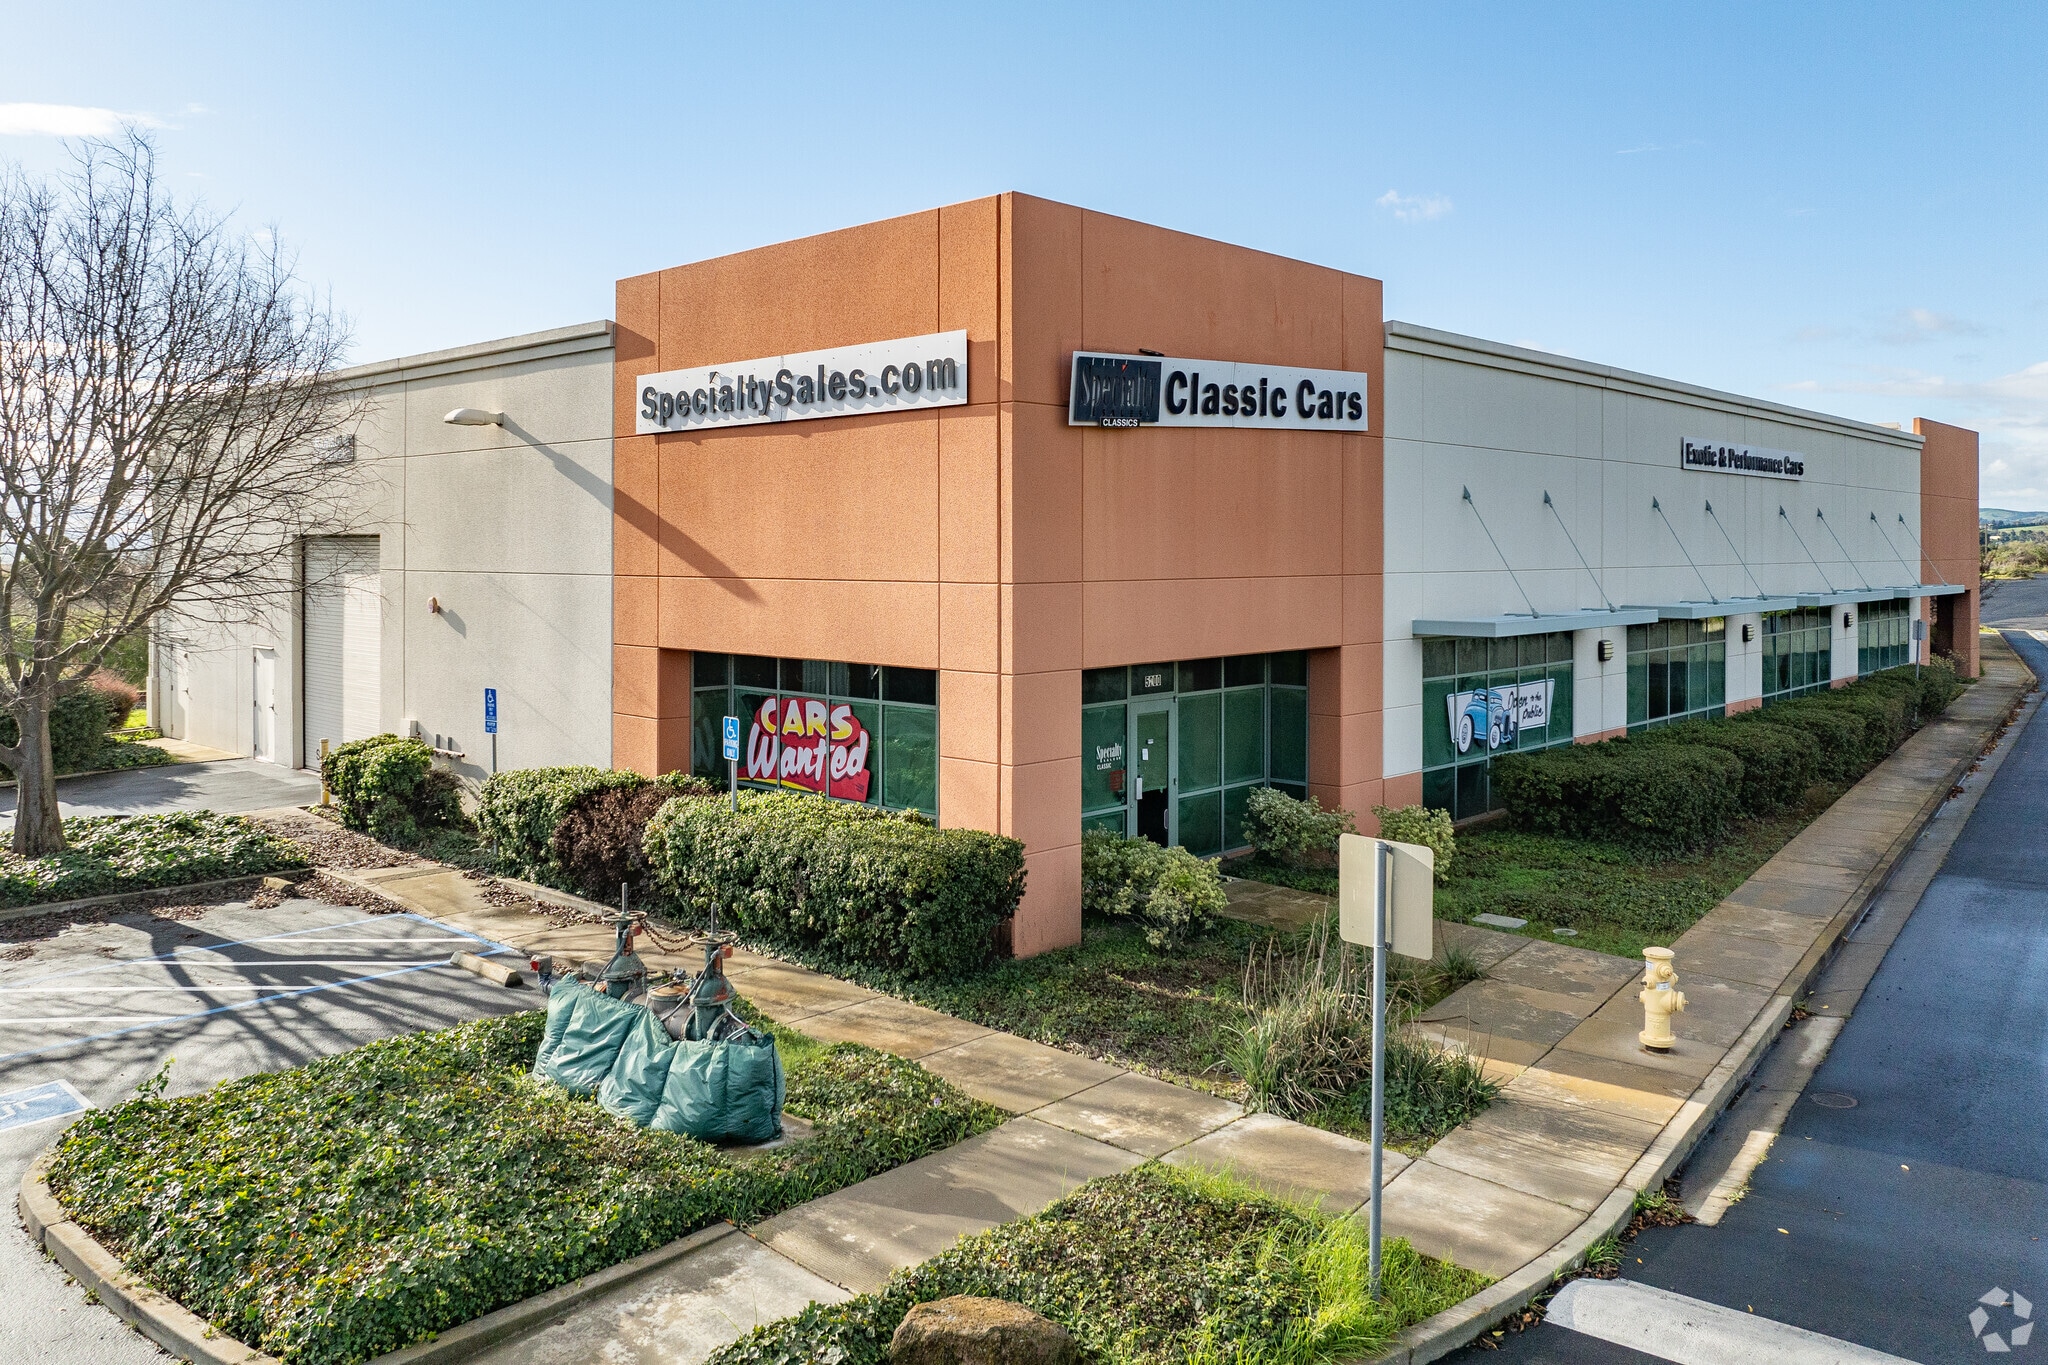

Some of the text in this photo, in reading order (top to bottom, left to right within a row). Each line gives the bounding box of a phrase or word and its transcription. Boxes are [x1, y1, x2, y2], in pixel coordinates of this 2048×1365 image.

[641, 357, 956, 428] SpecialtySales.com
[1166, 371, 1363, 420] Classic Cars
[1102, 418, 1138, 427] CLASSICS
[1686, 443, 1804, 475] Exotic & Performance Cars
[761, 698, 853, 740] CARS
[747, 722, 868, 782] Wanted
[1096, 743, 1122, 763] Specialty
